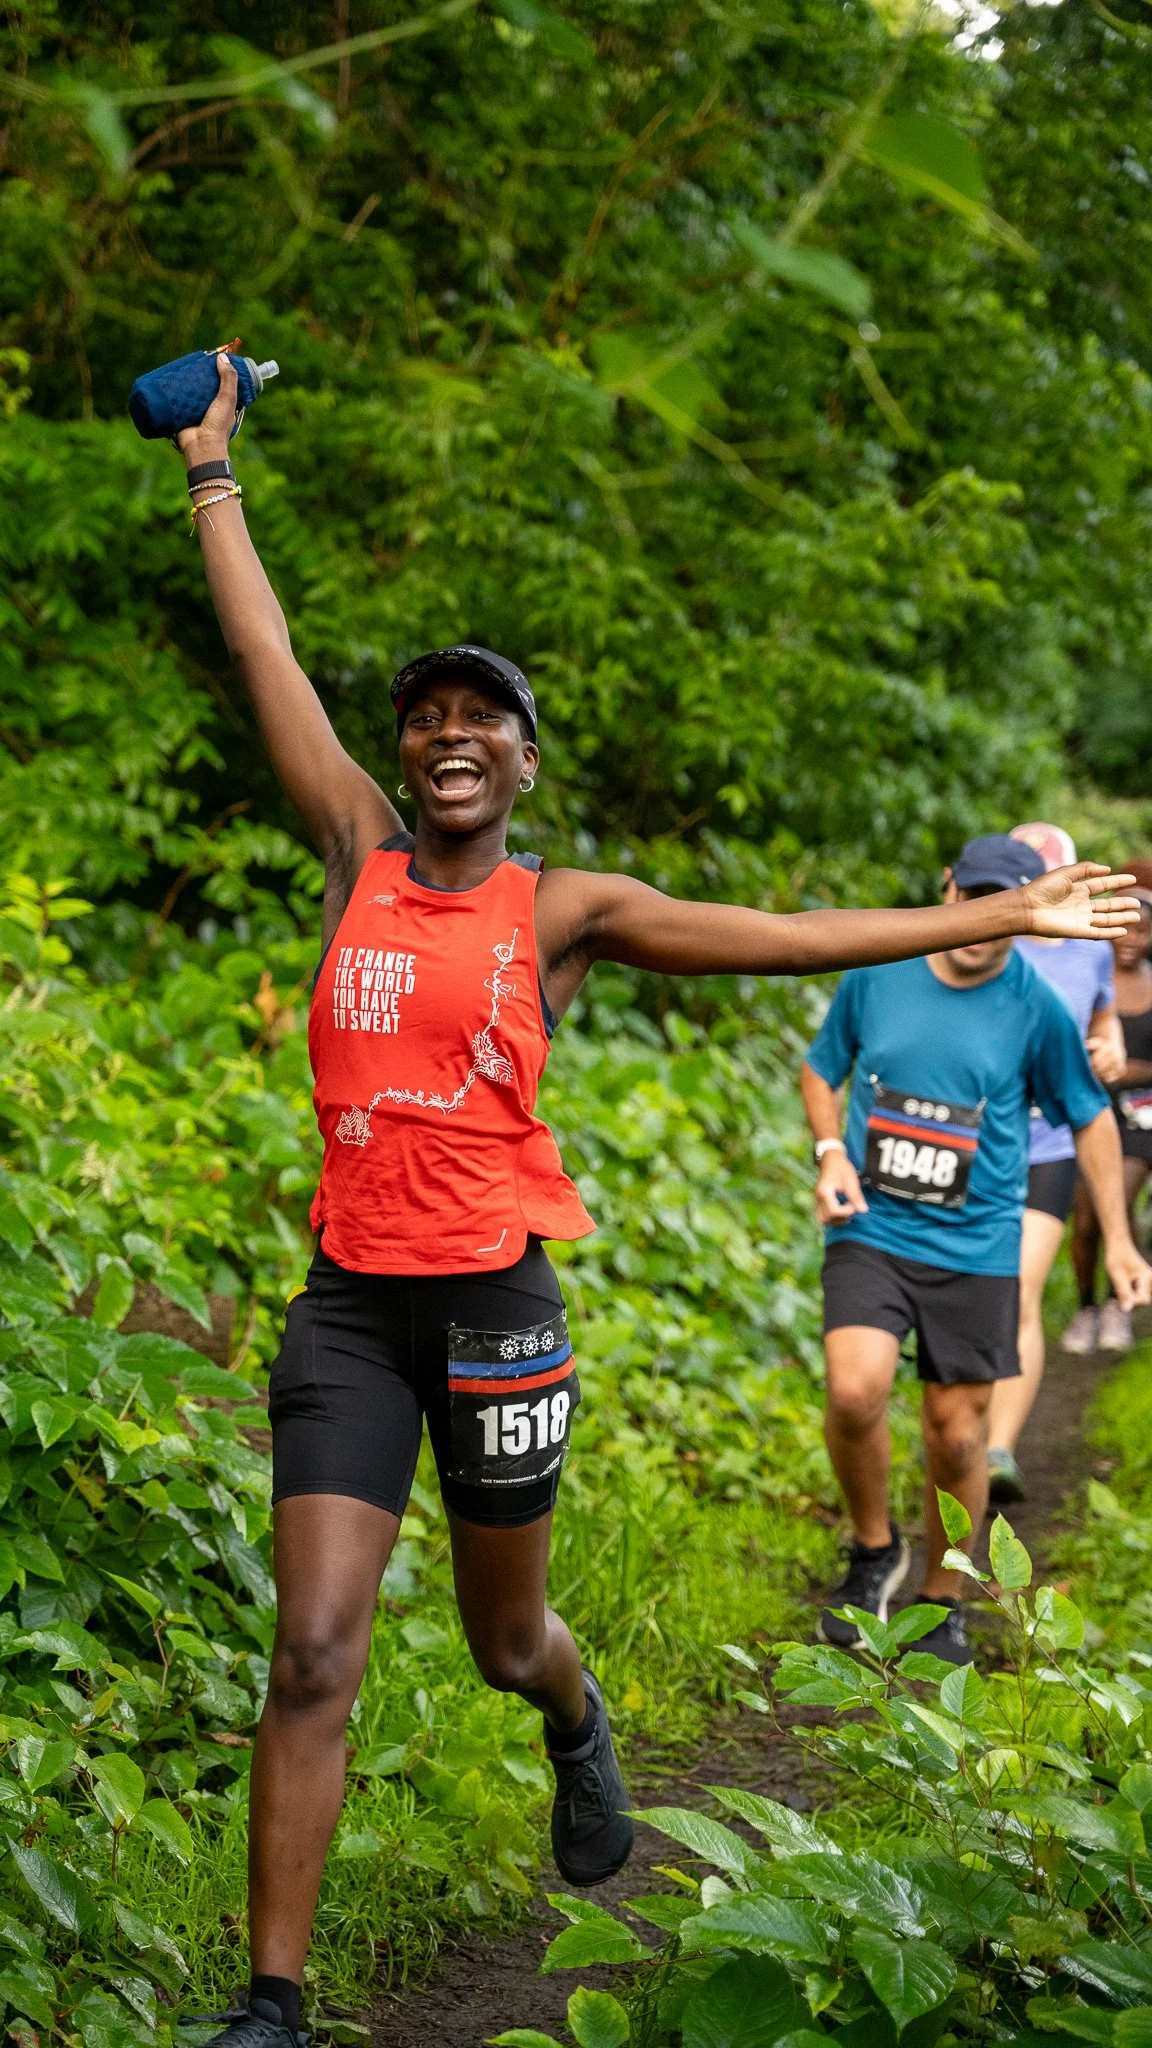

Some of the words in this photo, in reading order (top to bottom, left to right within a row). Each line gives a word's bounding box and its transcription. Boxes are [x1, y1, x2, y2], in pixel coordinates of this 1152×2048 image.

[338, 948, 353, 966] TO
[355, 948, 416, 973] CHANGE
[335, 967, 356, 988] THE
[361, 969, 415, 995] WORLD
[333, 988, 355, 1009] YOU
[360, 990, 400, 1013] HAVE
[333, 1009, 346, 1029] TO
[350, 1010, 400, 1034] SWEAT
[877, 1137, 958, 1187] 1948
[477, 1391, 570, 1455] 1518
[508, 1476, 531, 1484] SPONSORED
